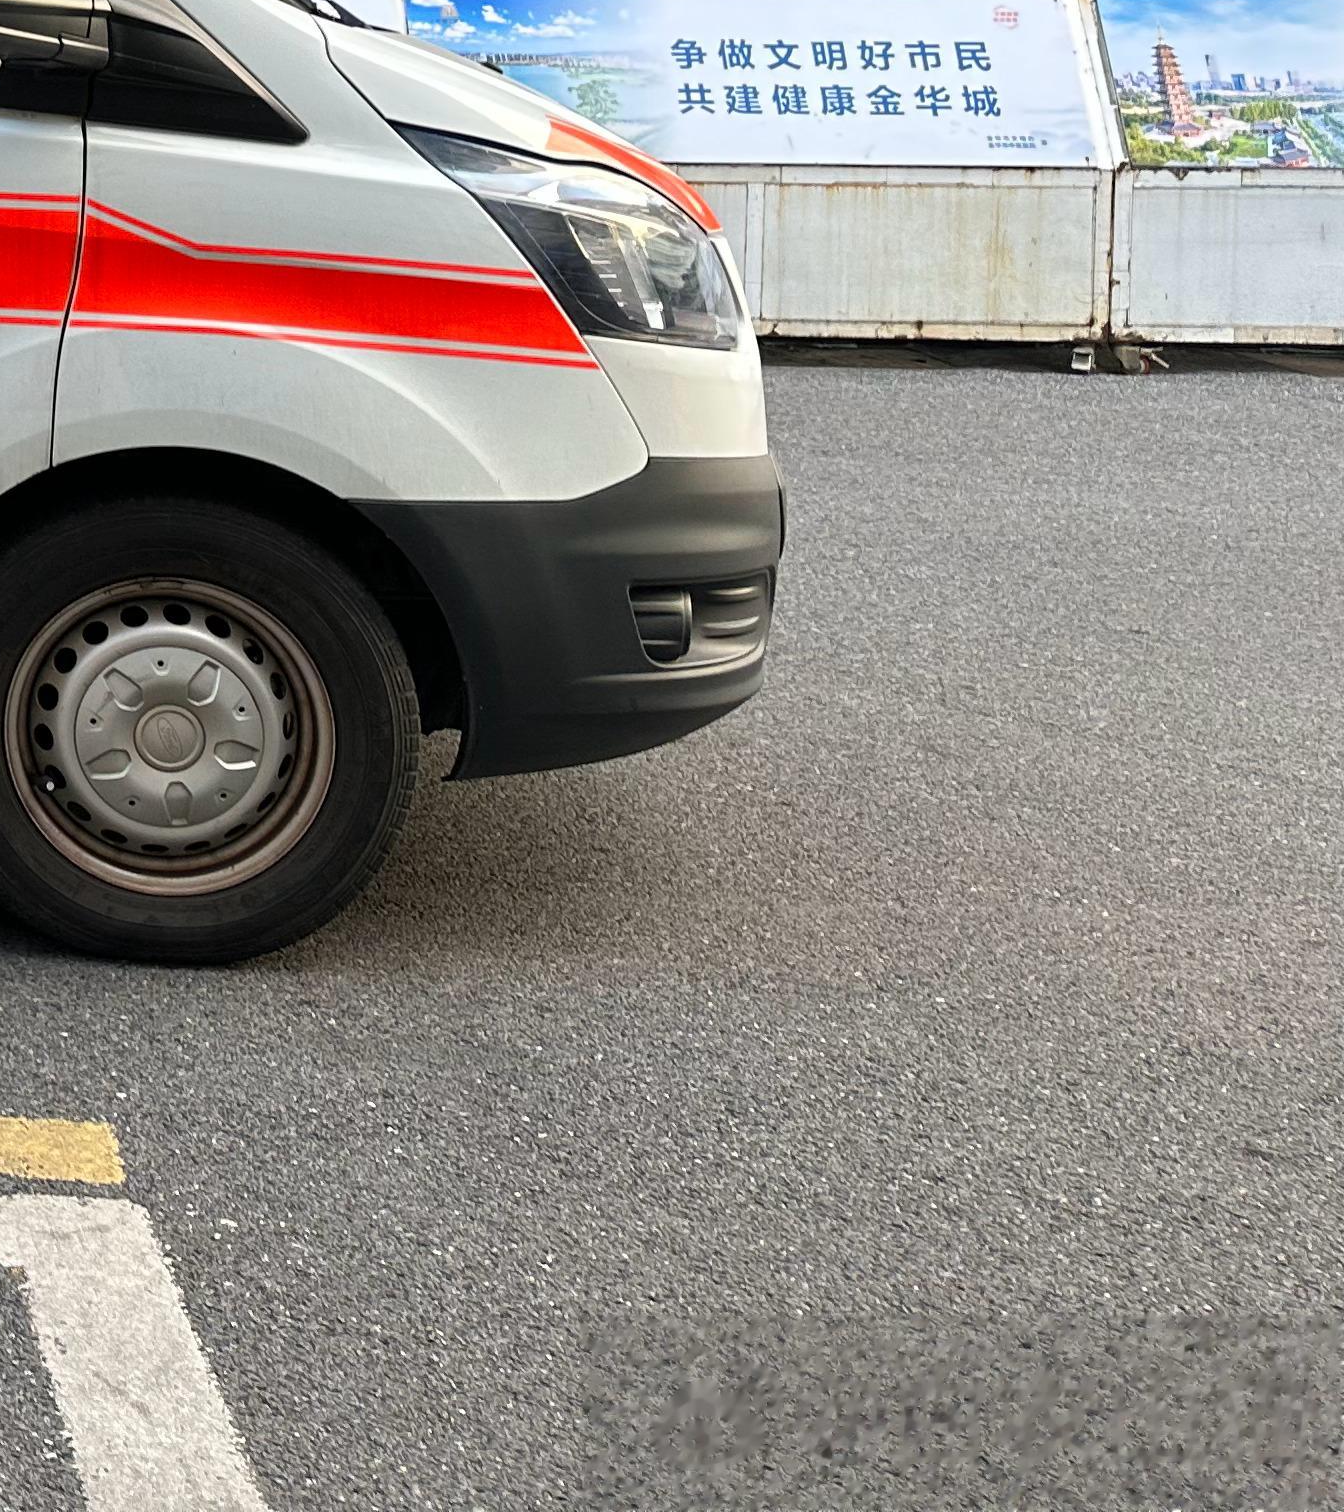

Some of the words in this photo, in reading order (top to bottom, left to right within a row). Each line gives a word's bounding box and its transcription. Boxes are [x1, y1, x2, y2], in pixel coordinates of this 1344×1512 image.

[670, 38, 992, 72] 争做文明好市民
[677, 82, 1002, 118] 共建健康金华城
